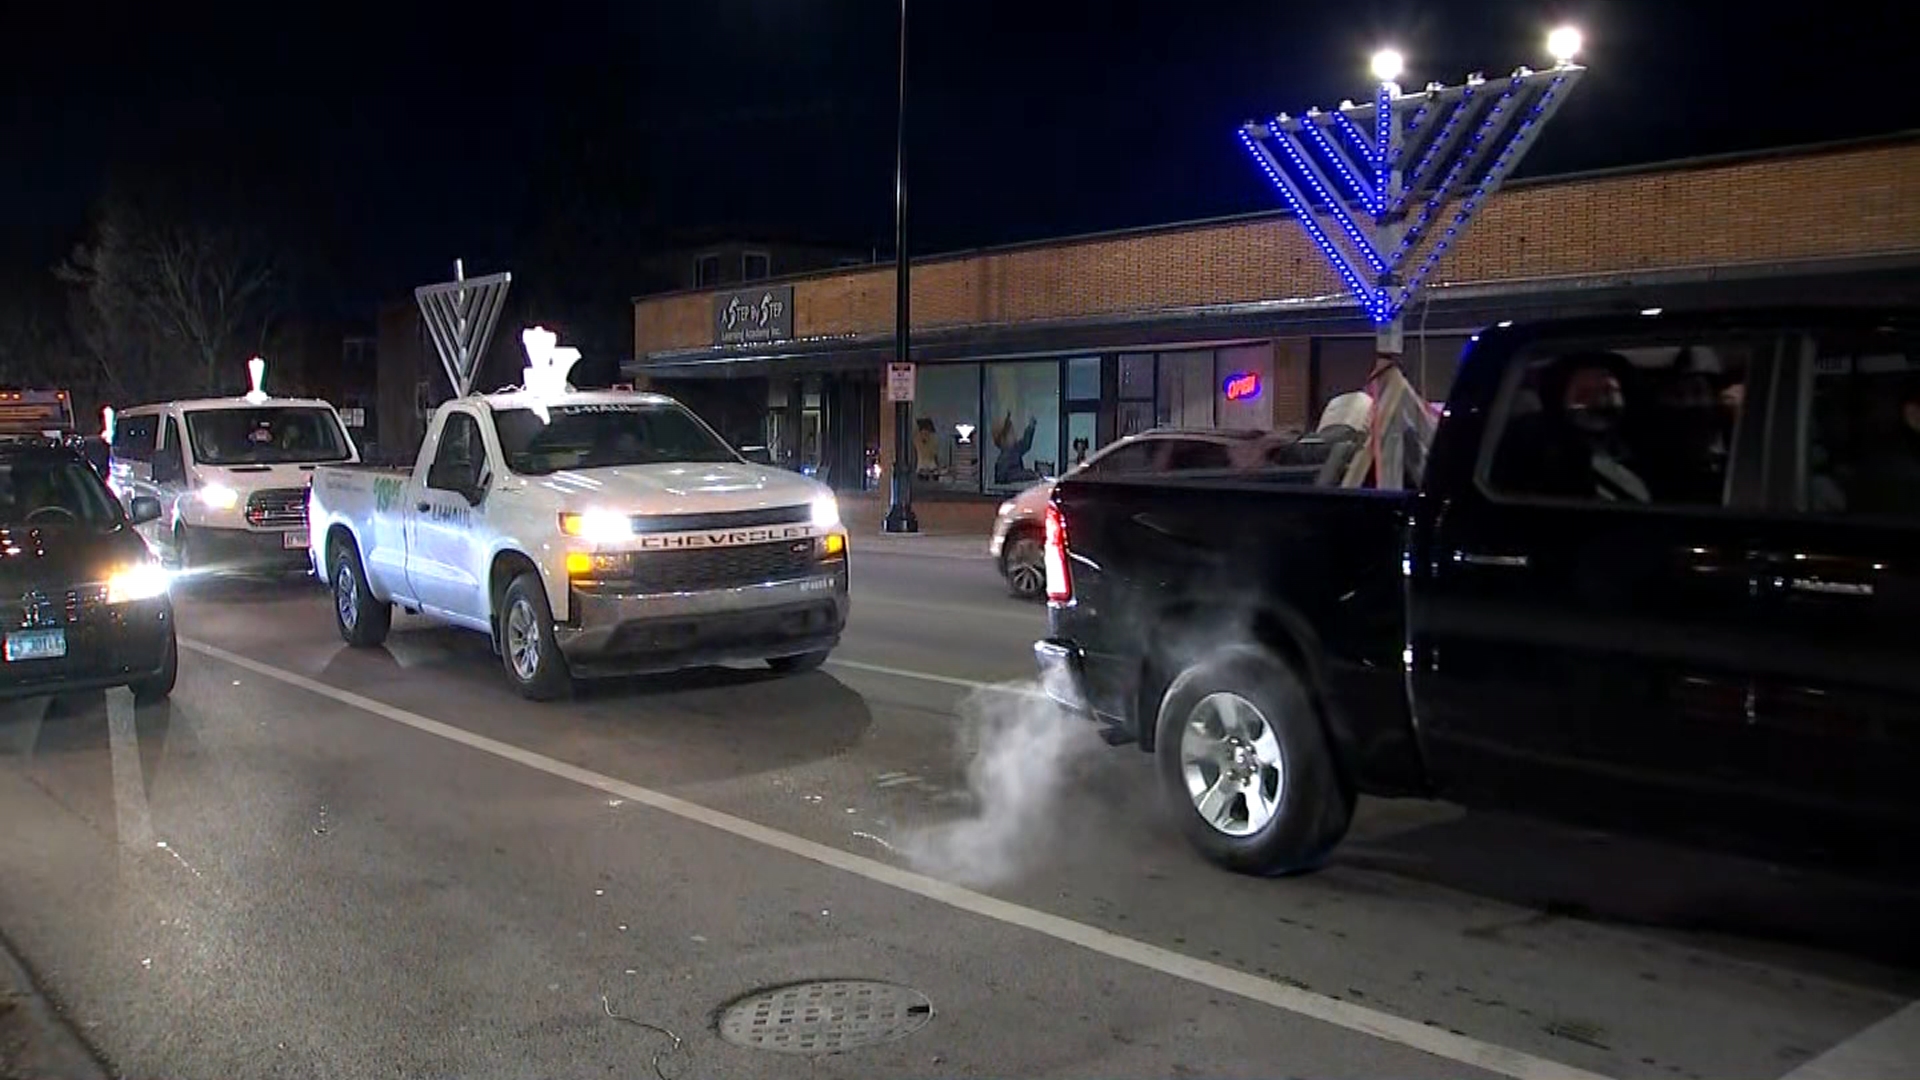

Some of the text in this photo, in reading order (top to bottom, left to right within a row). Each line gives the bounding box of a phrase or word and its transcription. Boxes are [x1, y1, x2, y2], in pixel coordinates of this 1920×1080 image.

[722, 308, 728, 324] A
[1228, 375, 1256, 399] OPEN
[641, 526, 812, 548] CHEVROLET
